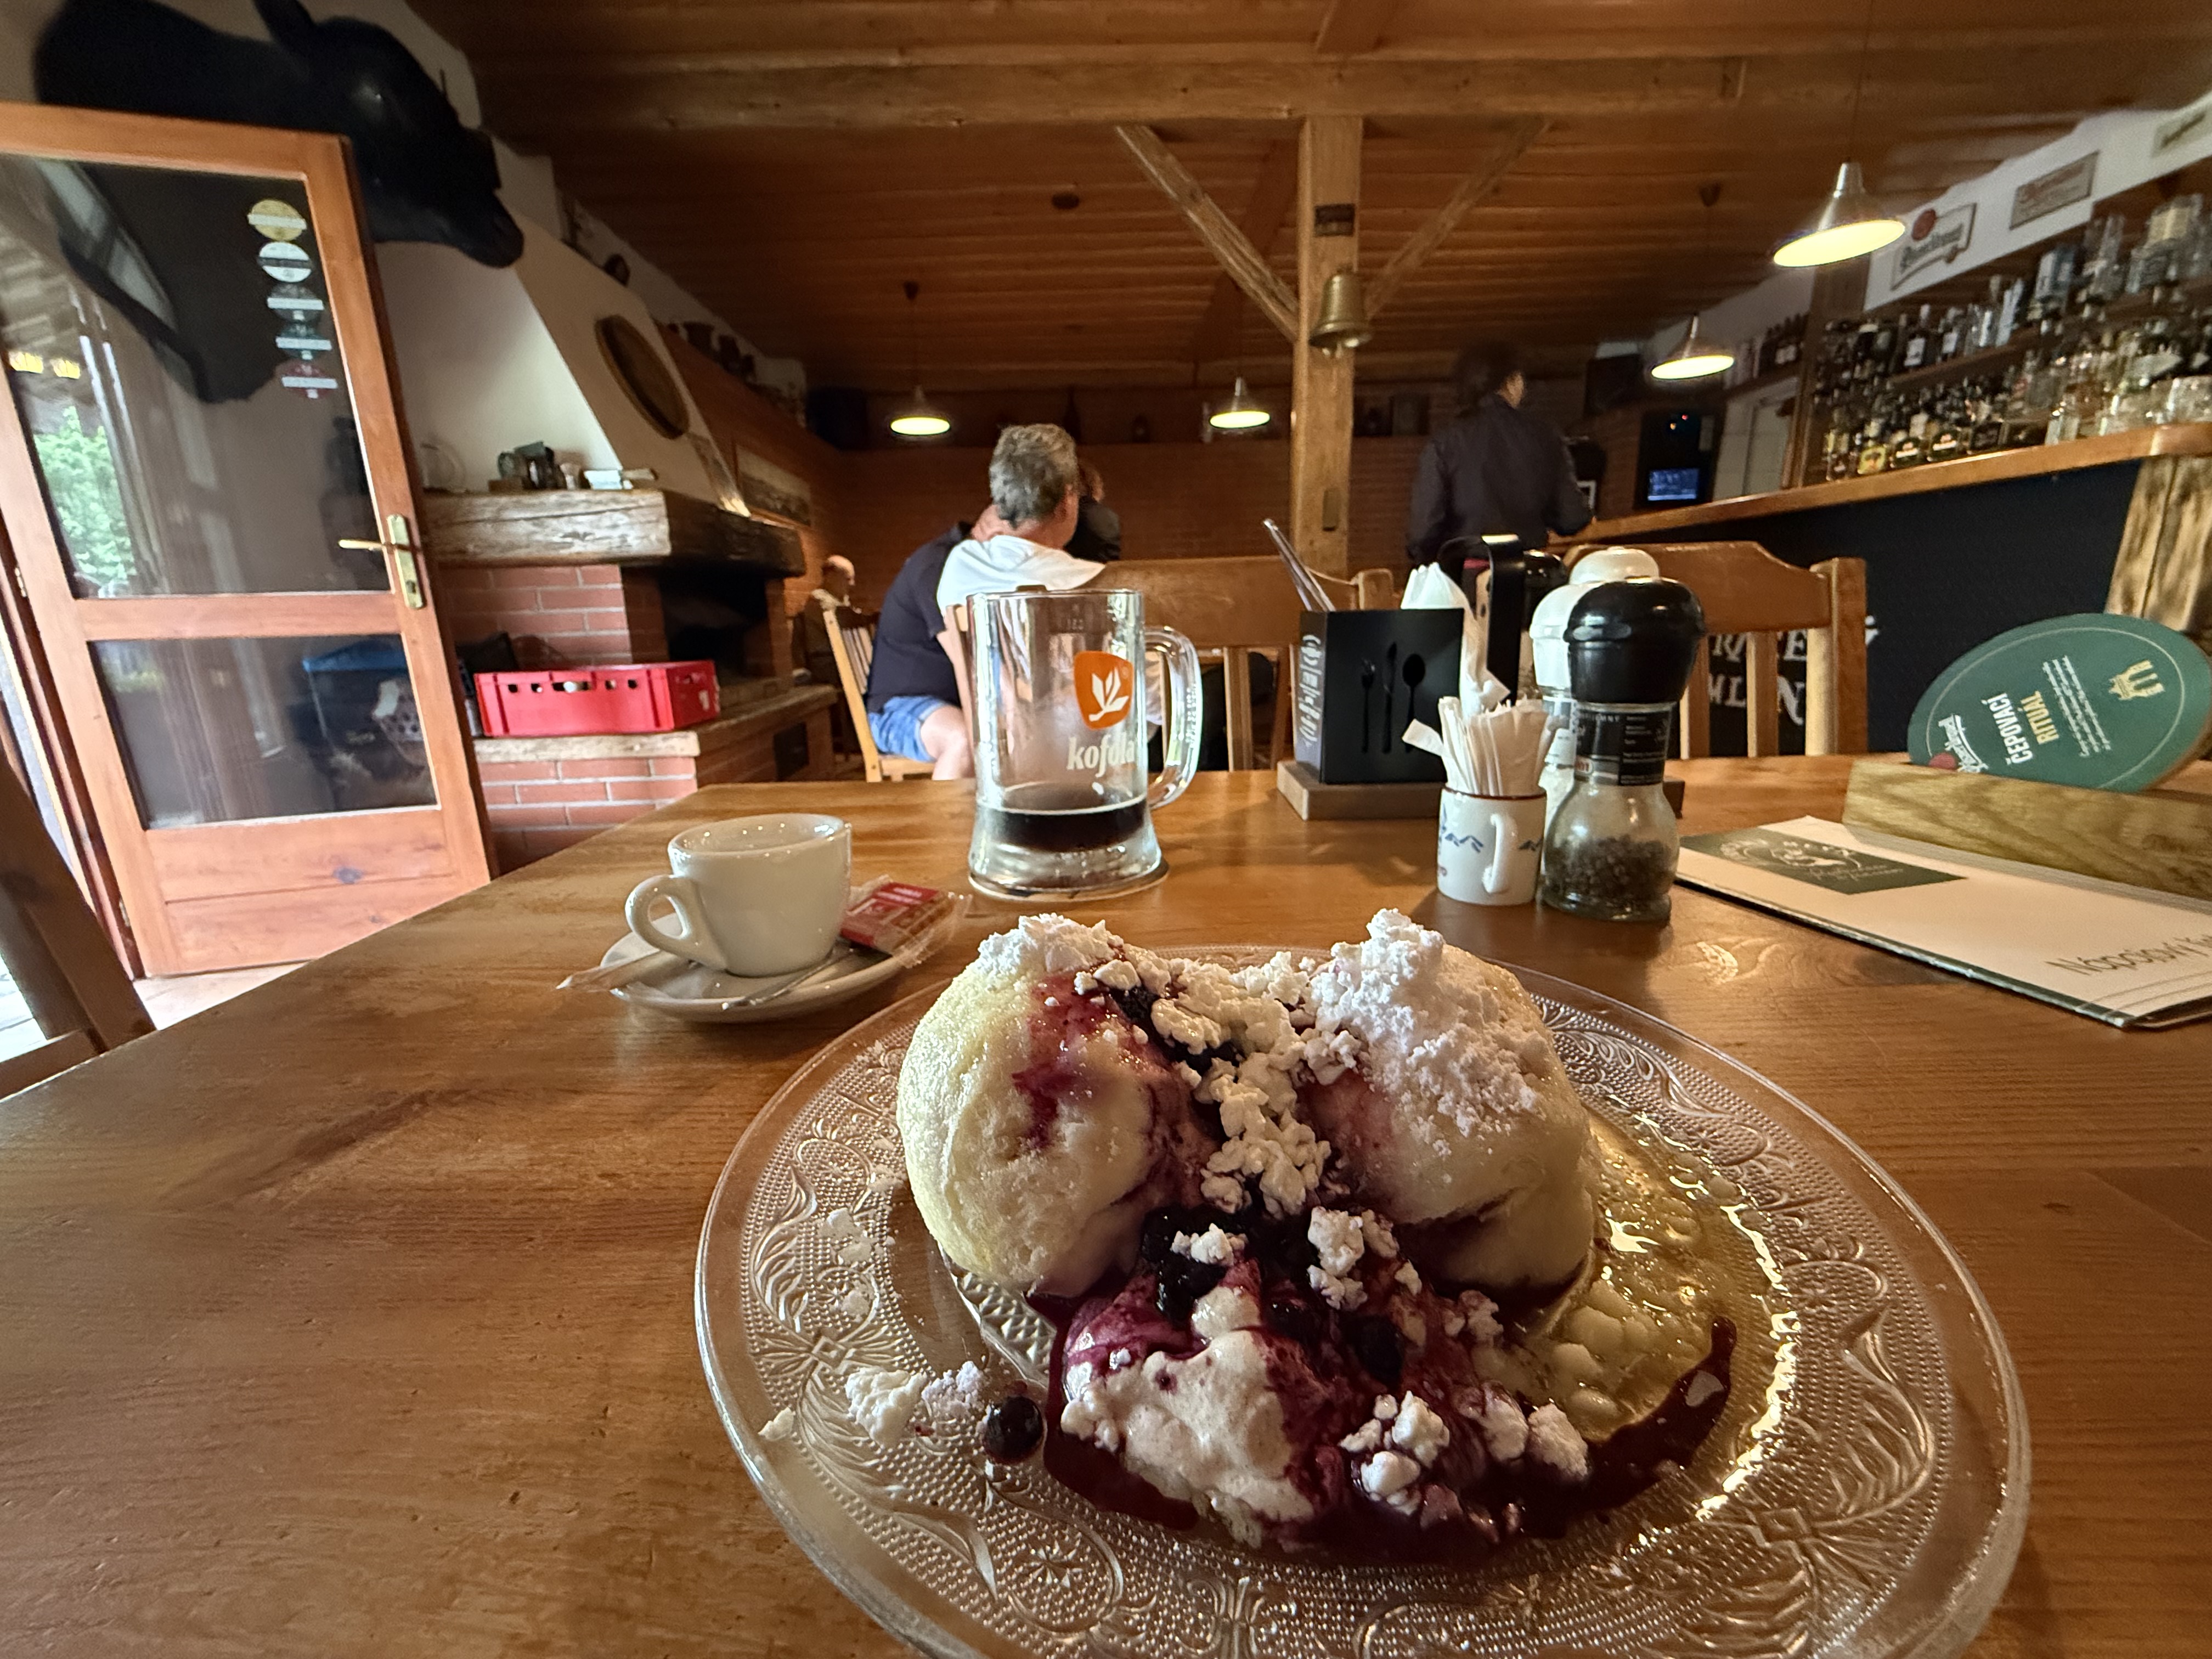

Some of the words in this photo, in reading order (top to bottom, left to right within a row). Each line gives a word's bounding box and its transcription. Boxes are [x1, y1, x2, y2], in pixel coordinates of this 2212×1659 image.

[1981, 693, 2033, 765] ČEPOVACÍ
[2018, 691, 2059, 744] RITUÁL
[1066, 732, 1136, 778] kofola
